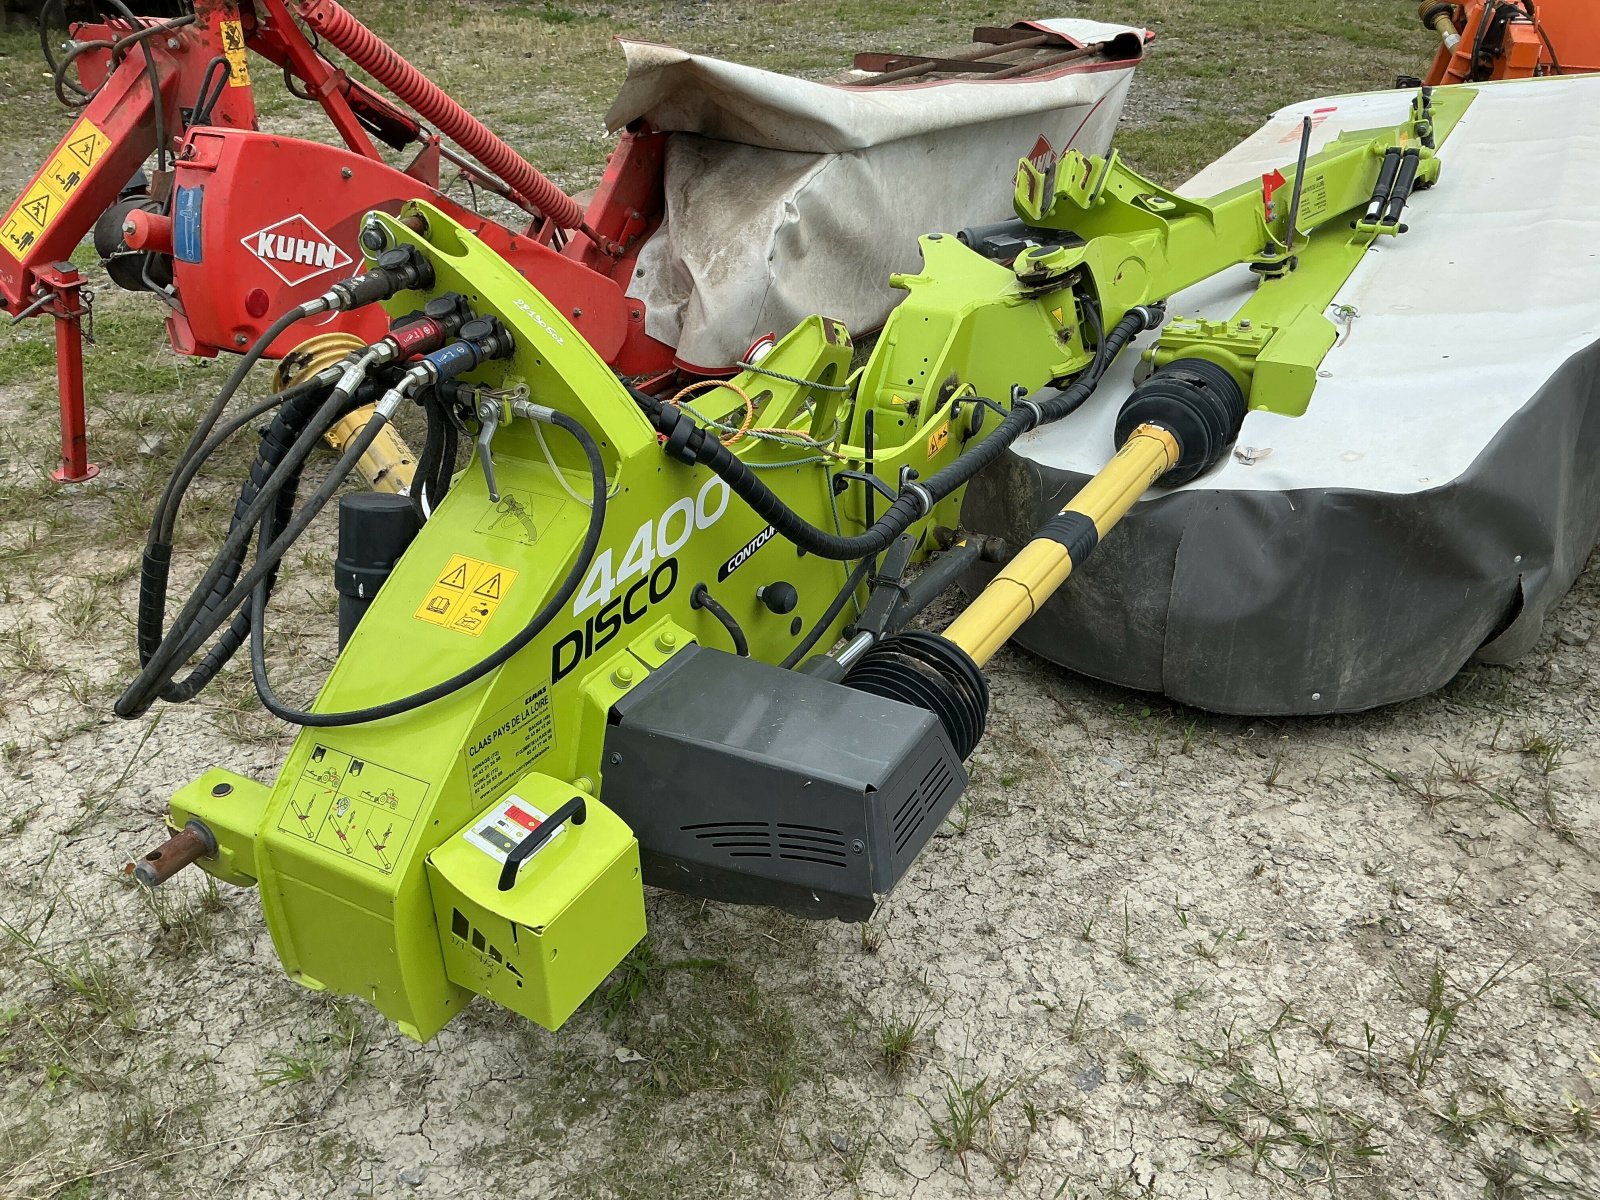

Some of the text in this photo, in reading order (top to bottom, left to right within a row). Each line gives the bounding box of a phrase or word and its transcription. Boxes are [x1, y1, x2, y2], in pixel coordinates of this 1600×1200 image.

[257, 230, 337, 270] KUHN
[573, 474, 731, 618] 4400
[551, 557, 679, 686] DISCO
[469, 694, 549, 757] CLAAS PAYS DE LA LOIRE
[524, 686, 547, 706] CLAAS
